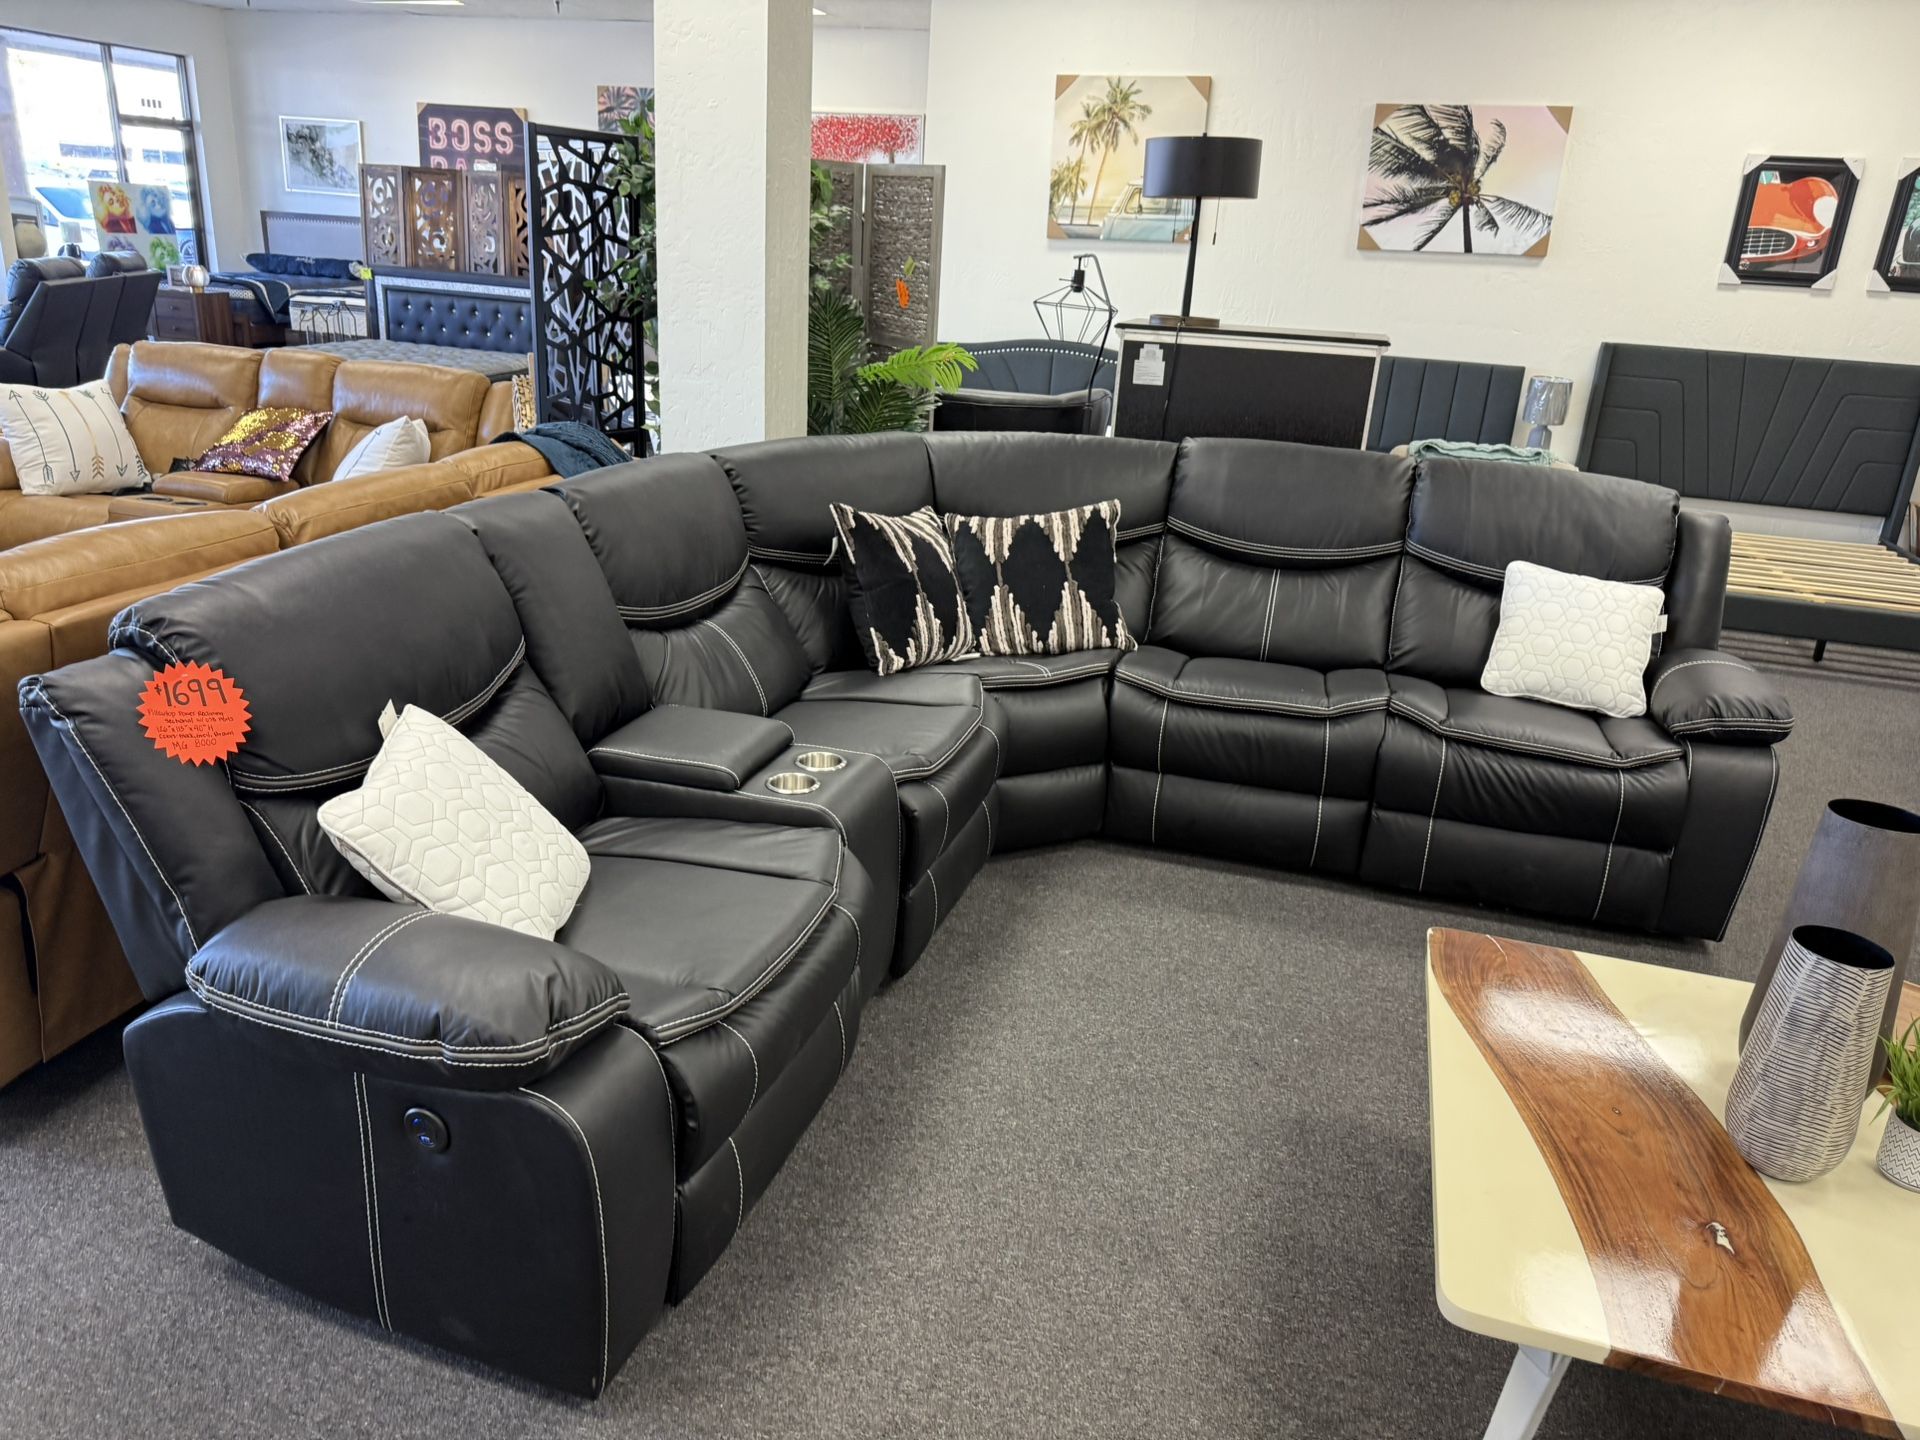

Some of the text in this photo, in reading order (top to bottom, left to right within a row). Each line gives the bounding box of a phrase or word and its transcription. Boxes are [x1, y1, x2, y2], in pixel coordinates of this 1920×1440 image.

[428, 117, 514, 155] BOSS
[154, 678, 227, 707] $1699
[171, 738, 216, 750] MG 8000
